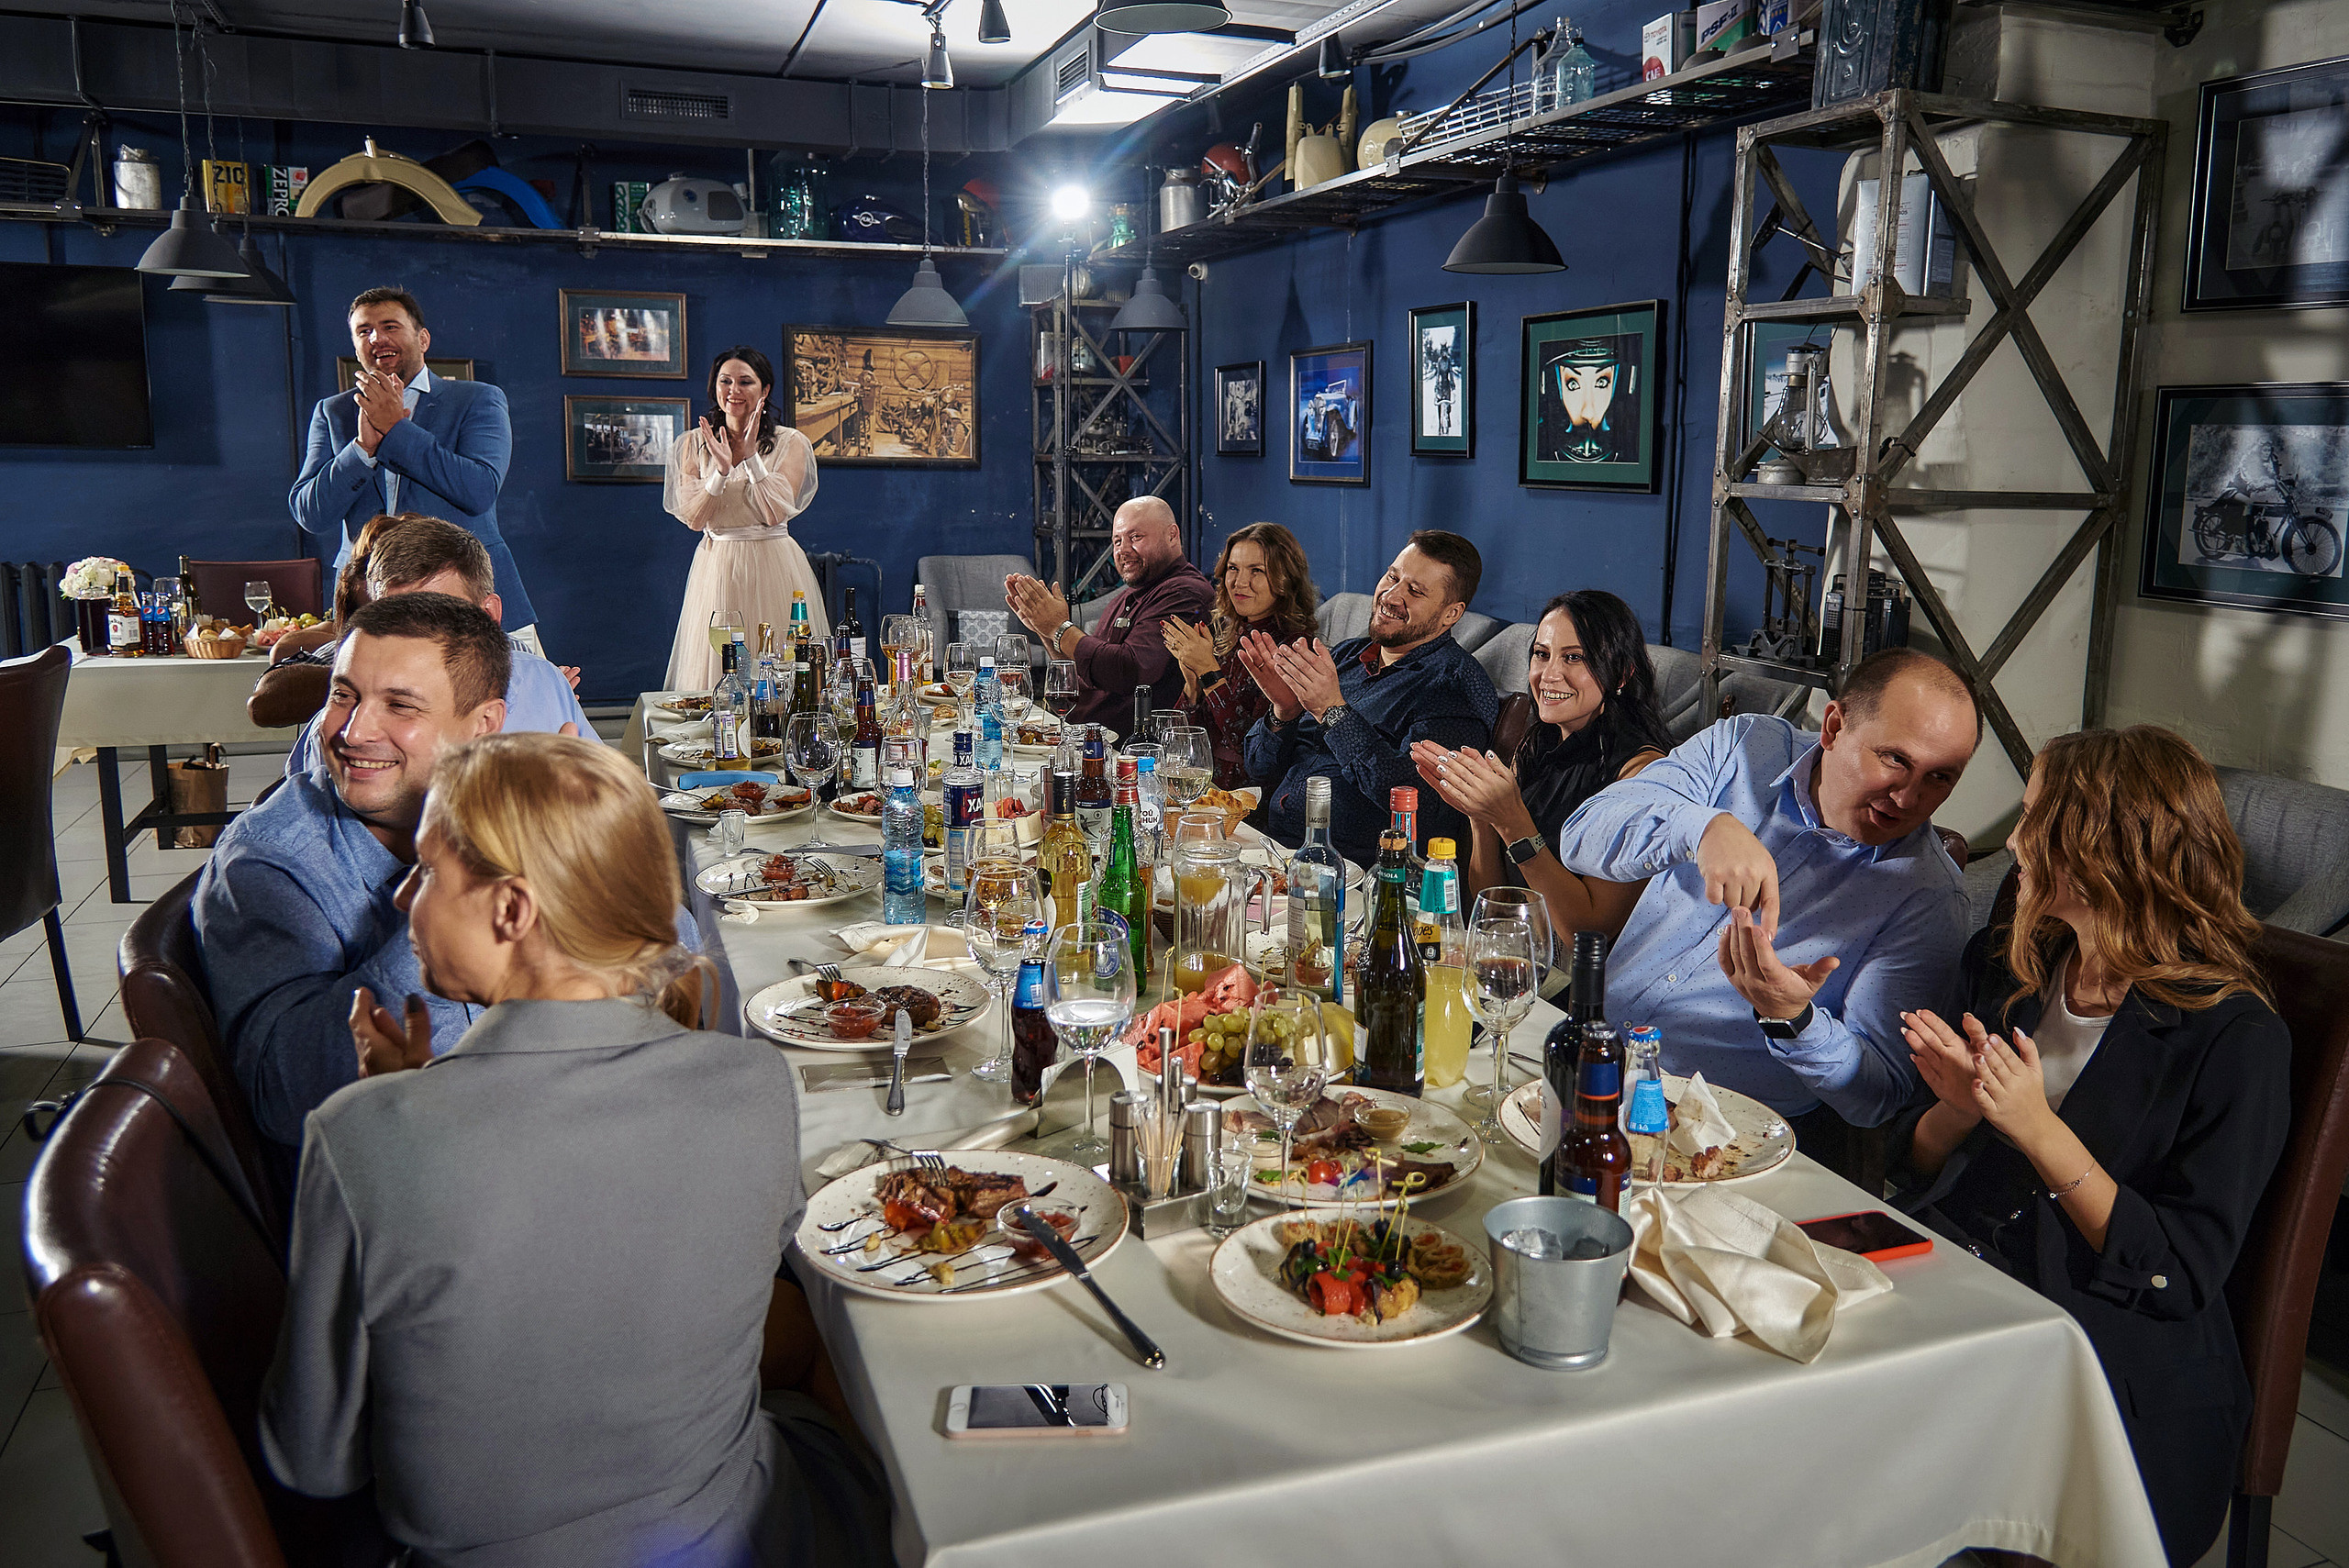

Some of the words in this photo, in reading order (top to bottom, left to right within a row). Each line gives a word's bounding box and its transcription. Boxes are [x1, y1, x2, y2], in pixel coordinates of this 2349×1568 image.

[1700, 4, 1739, 44] PSF-II
[215, 165, 245, 183] ZIC
[1336, 909, 1345, 923] LA
